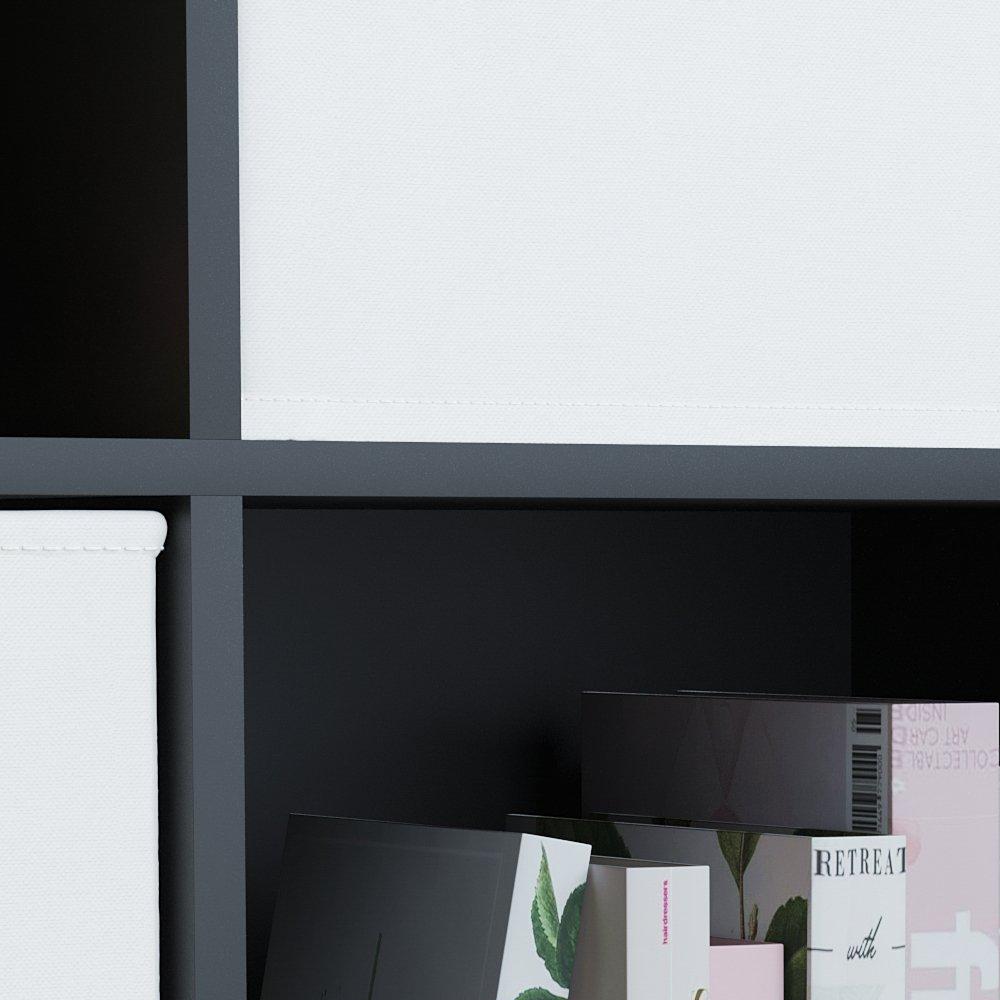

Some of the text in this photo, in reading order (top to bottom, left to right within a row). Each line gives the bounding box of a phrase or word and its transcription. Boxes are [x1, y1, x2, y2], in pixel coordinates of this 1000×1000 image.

[813, 847, 906, 878] RETREAT
[661, 879, 670, 945] hairdressers
[846, 916, 884, 963] with
